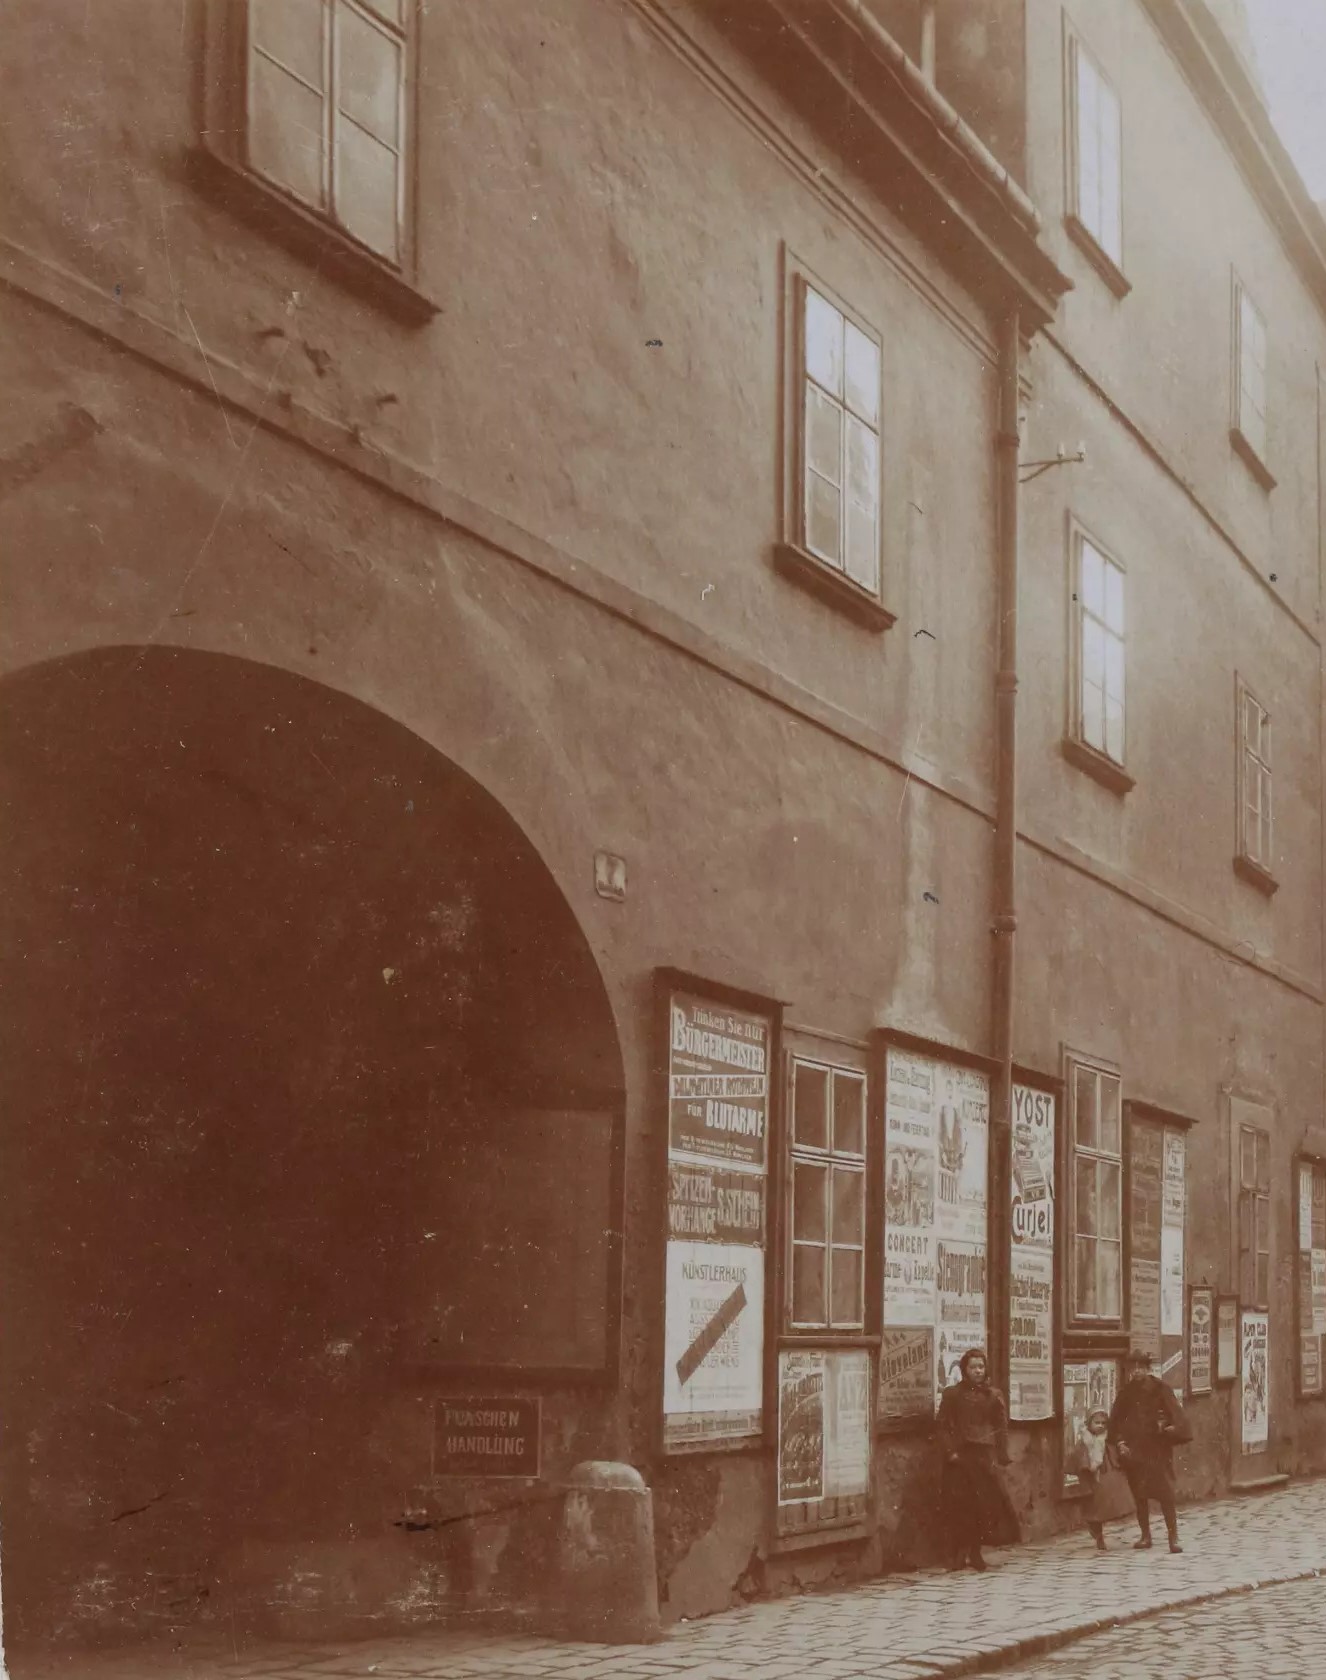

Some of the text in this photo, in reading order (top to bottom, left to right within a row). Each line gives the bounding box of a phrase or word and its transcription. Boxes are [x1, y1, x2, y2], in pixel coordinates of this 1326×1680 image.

[692, 1006, 764, 1041] Trinken Sie nur
[706, 1099, 764, 1138] BLUTARME
[1013, 1088, 1051, 1128] YOST
[887, 1233, 928, 1256] CONCERT
[681, 1259, 747, 1282] KÜNSTLERHAUS
